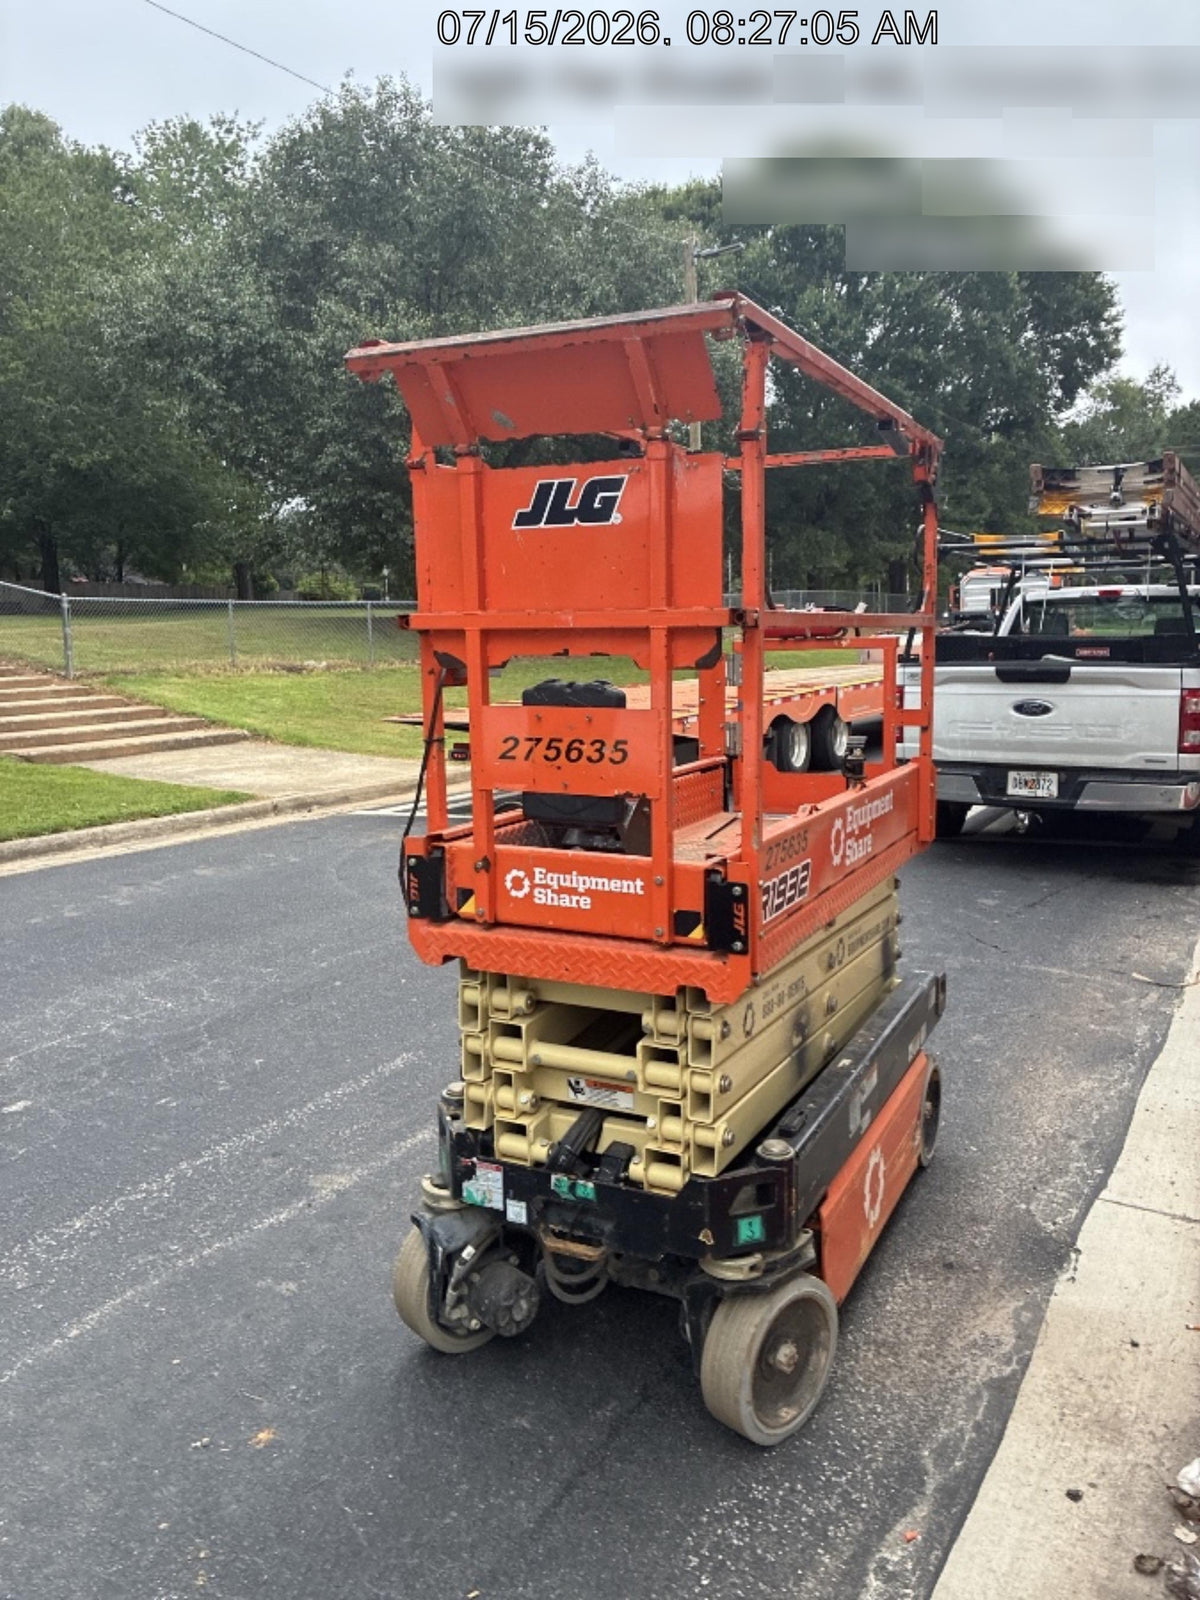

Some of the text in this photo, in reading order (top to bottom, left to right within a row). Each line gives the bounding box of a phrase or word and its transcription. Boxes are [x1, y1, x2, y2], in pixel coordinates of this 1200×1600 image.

[511, 475, 628, 530] JLG
[499, 736, 629, 764] 275635
[846, 788, 893, 835] Equipment
[765, 829, 808, 871] 275635
[846, 832, 872, 866] Share
[533, 867, 644, 896] Equipment
[533, 887, 592, 909] Share
[734, 902, 745, 936] JLG
